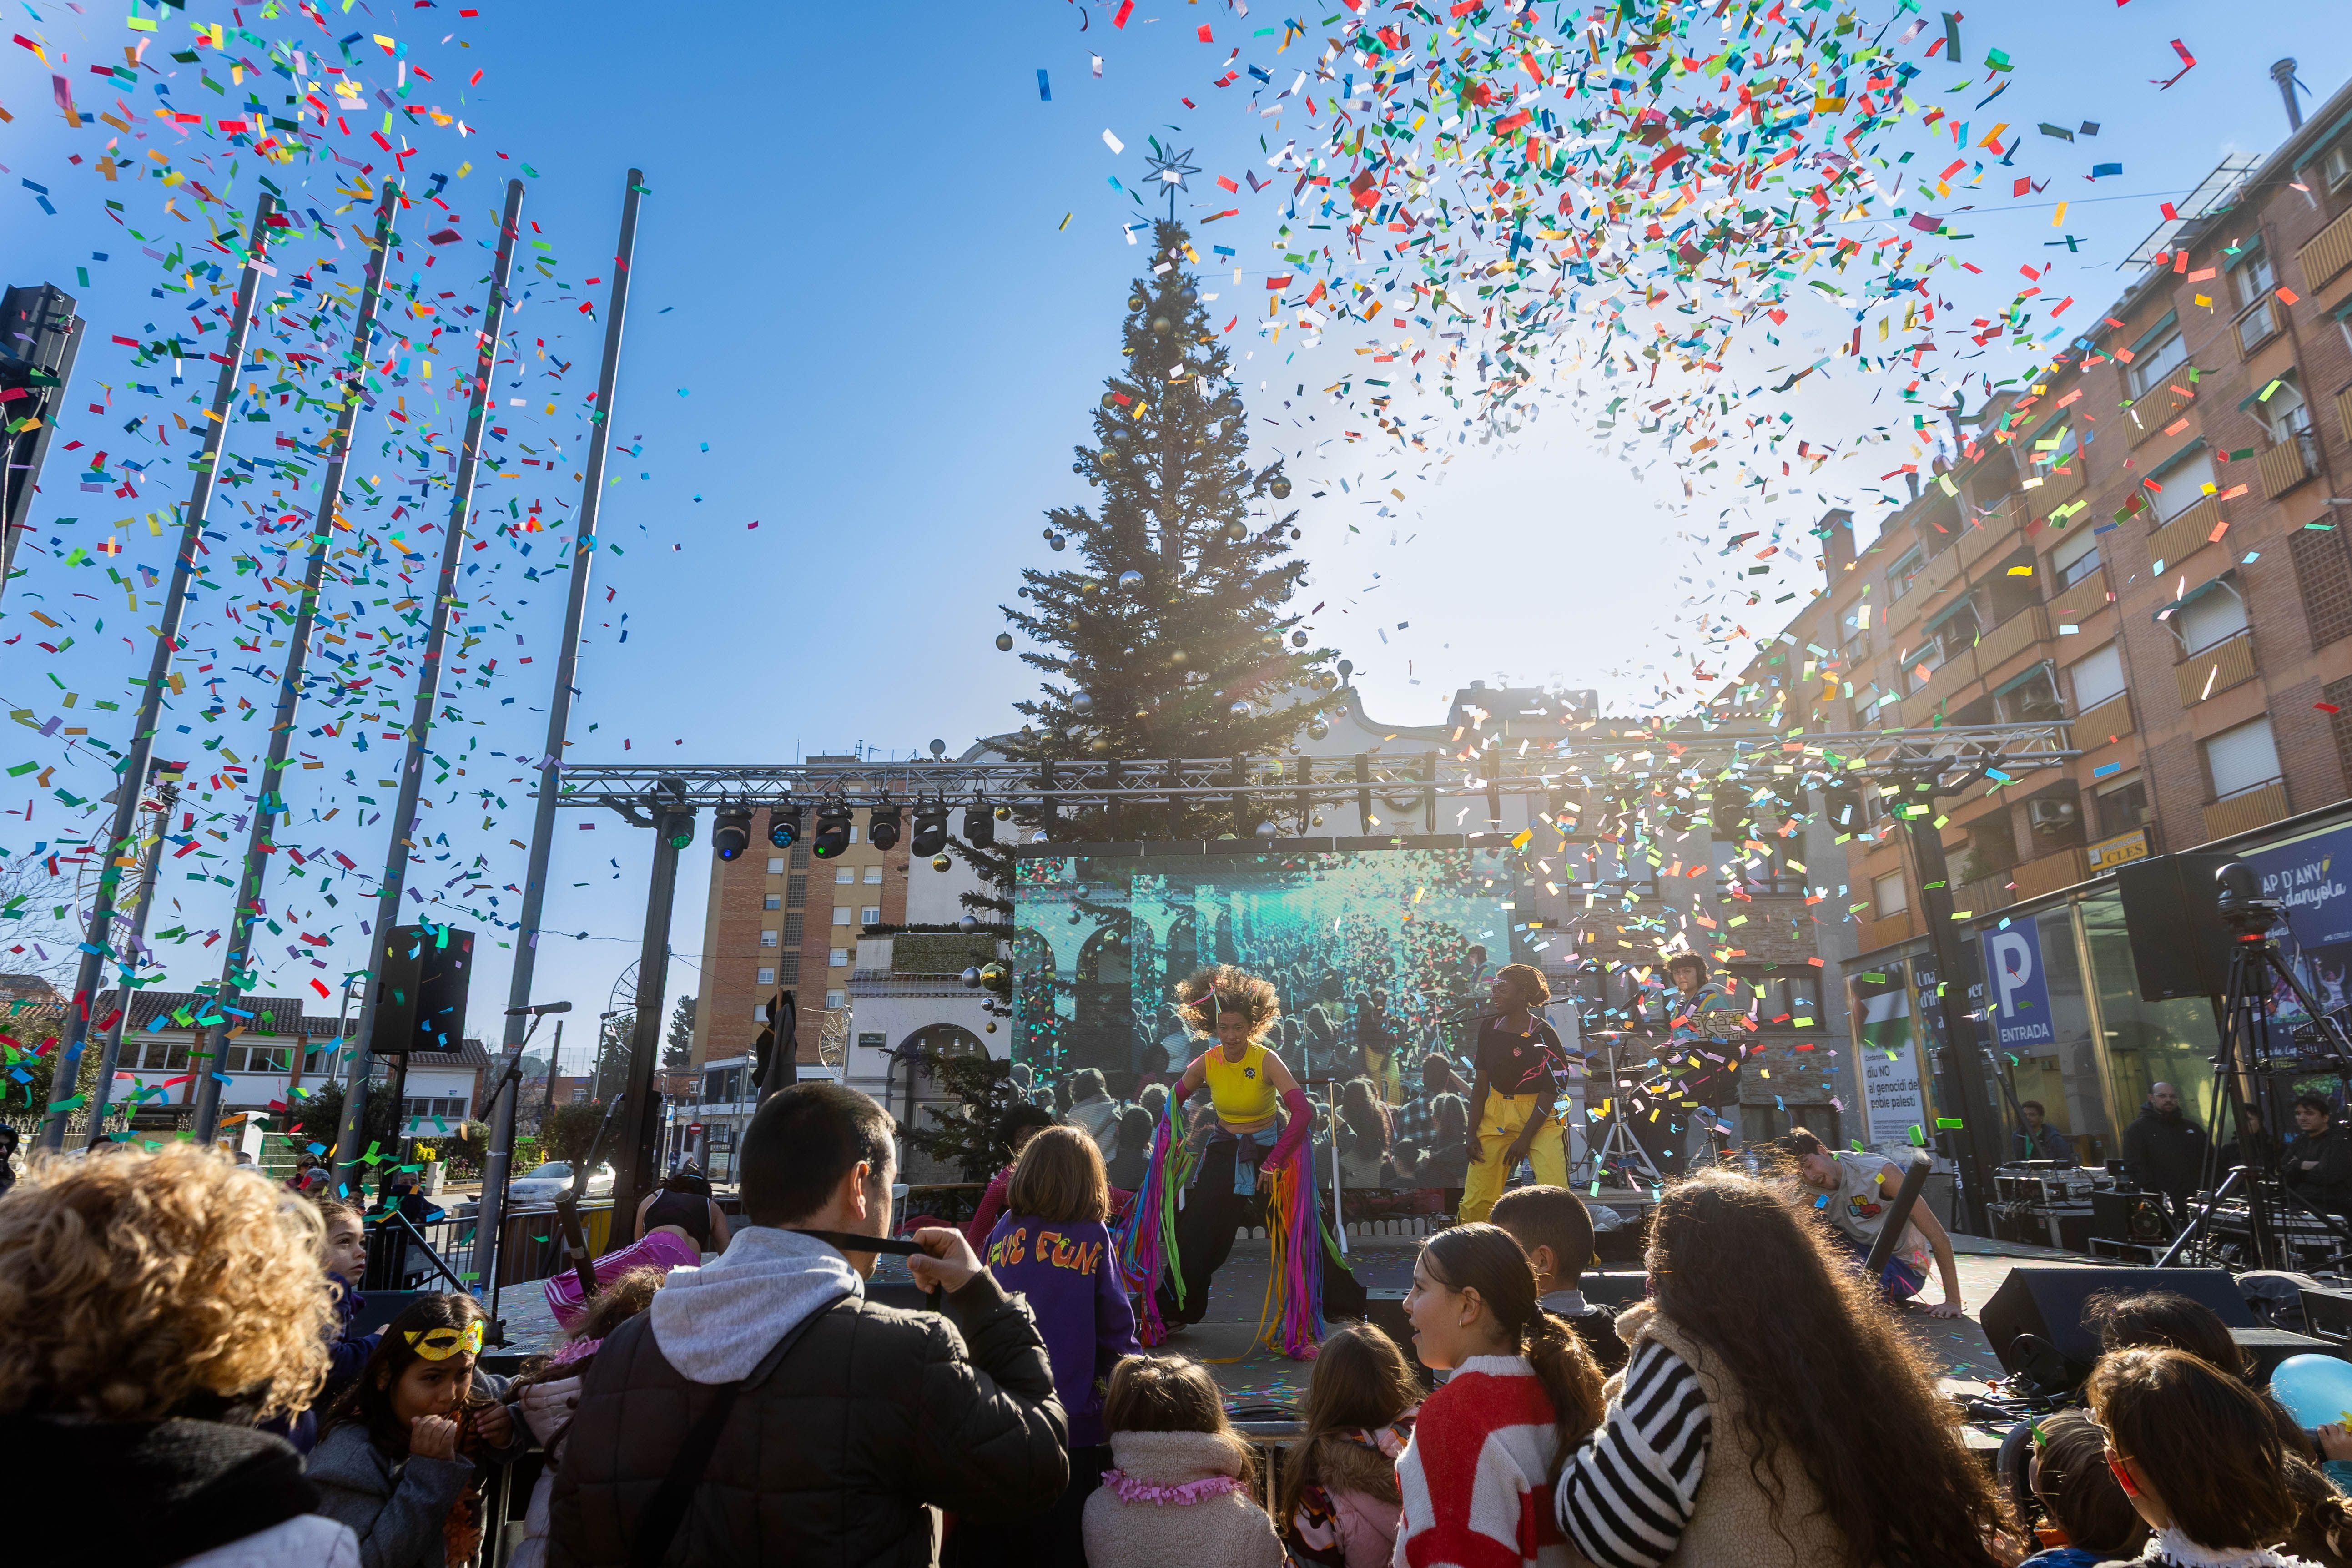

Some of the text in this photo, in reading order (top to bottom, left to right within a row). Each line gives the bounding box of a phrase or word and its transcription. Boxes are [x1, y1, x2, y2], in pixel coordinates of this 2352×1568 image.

[2100, 833, 2145, 852] PSICOLOGIA
[2107, 843, 2143, 863] CLES
[2262, 862, 2321, 894] AP D'ANY
[2274, 879, 2346, 909] danyola
[1916, 971, 1936, 987] Una
[1992, 932, 2032, 1018] P
[2001, 1023, 2050, 1043] ENTRADA
[1867, 1065, 1890, 1078] diu NO
[1869, 1077, 1920, 1096] al genocidi del
[1870, 1094, 1916, 1111] poble palestí
